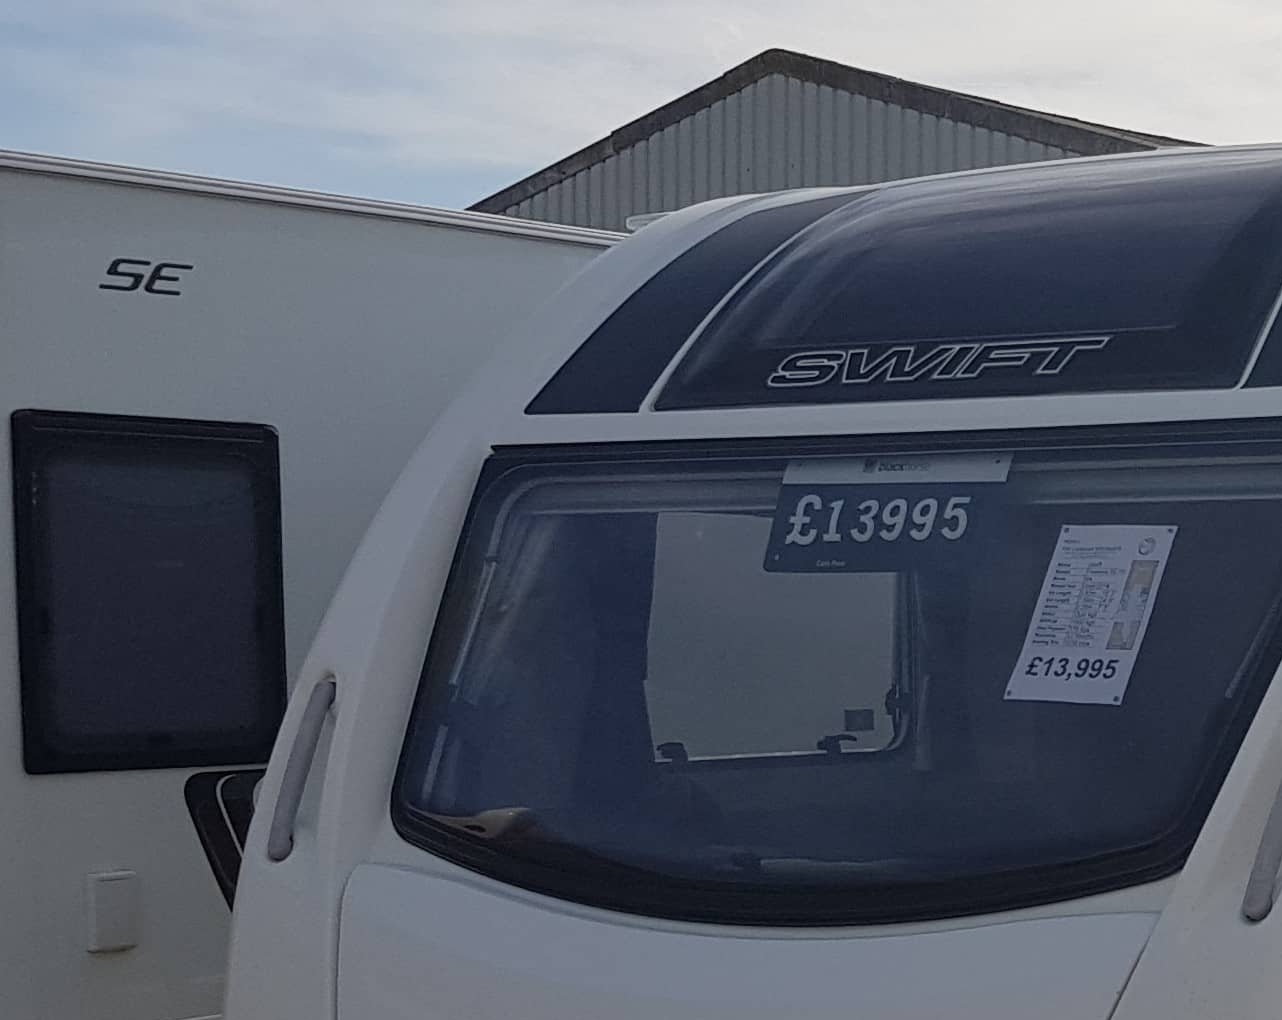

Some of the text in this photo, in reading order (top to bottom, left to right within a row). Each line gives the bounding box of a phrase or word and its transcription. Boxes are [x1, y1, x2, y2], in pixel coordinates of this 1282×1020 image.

[98, 258, 194, 296] SE
[767, 336, 1110, 388] SWIFT
[784, 494, 971, 546] £13995
[1025, 656, 1120, 681] £13,995
